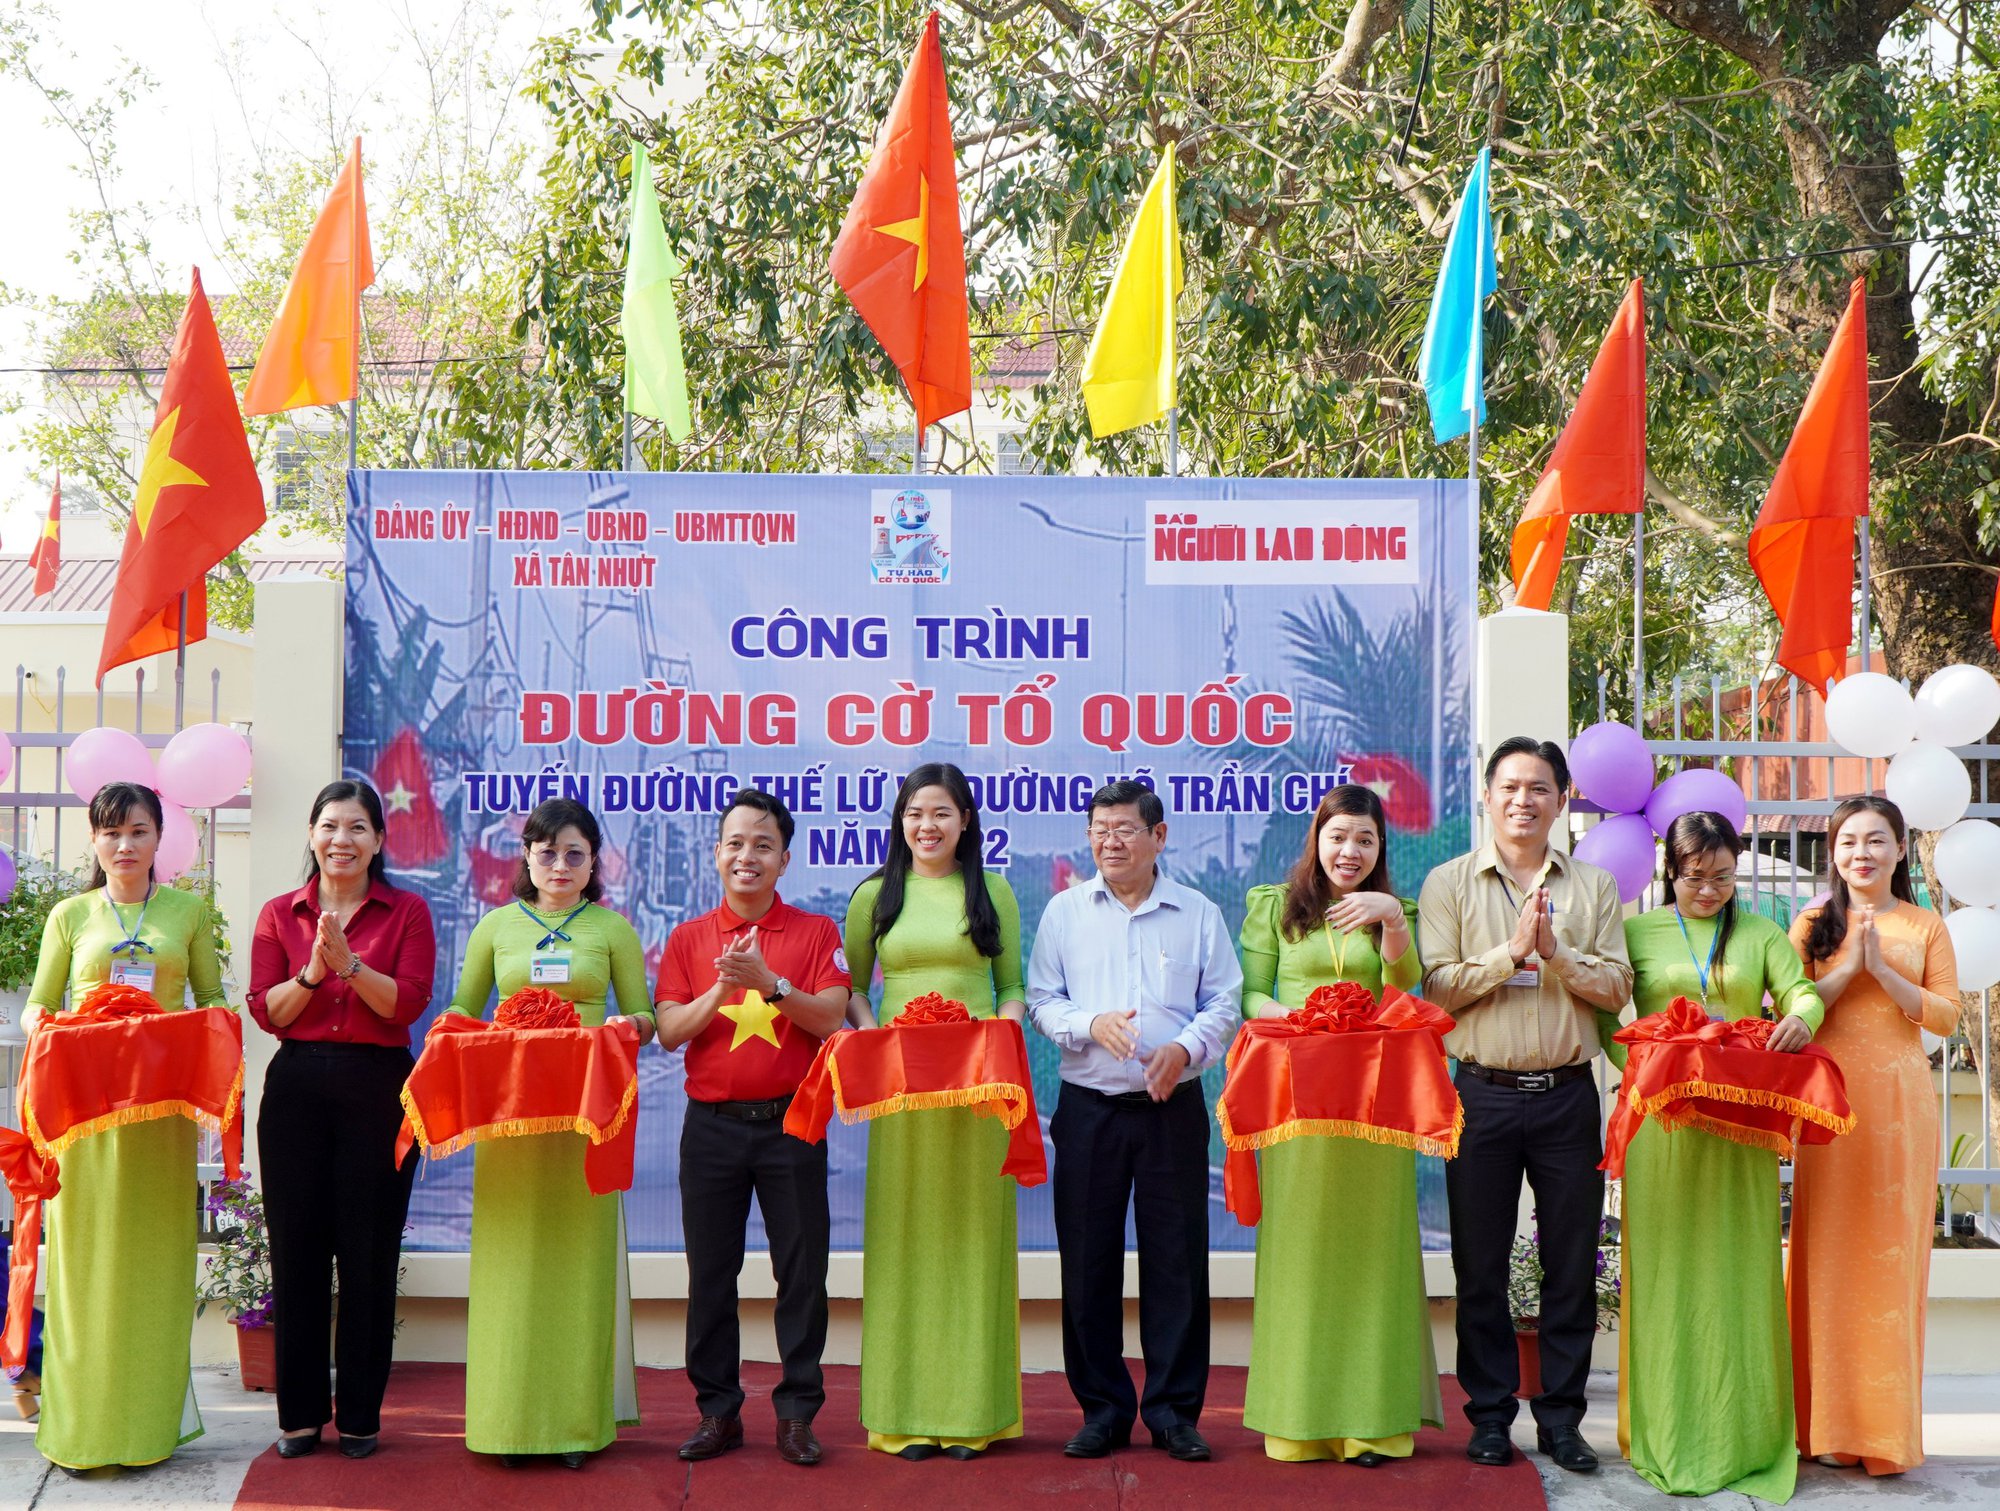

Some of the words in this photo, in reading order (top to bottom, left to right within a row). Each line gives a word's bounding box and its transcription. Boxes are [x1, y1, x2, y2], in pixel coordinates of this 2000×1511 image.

[375, 503, 434, 539] ĐẢNG
[442, 503, 471, 540] ỦY
[498, 511, 559, 541] HĐND
[587, 511, 648, 542] UBND
[675, 512, 796, 546] UBMTTQVN
[1154, 512, 1198, 525] BÁO
[1154, 524, 1246, 562] NGƯỜI
[1256, 527, 1313, 561] LAO
[1322, 524, 1406, 563] ĐỘNG
[514, 552, 543, 586] XÃ
[549, 552, 590, 587] TÂN
[598, 553, 656, 593] NHỰT
[731, 608, 888, 659] CÔNG
[916, 608, 1089, 659] TRÌNH
[519, 681, 796, 746] ĐƯỜNG
[826, 682, 934, 746] CỜ
[958, 674, 1057, 746] TỔ
[1083, 676, 1293, 752] QUỐC
[465, 763, 589, 812] TUYẾN
[603, 767, 739, 812] ĐƯỜNG
[752, 764, 826, 812] THẾ
[837, 768, 888, 812] LỮ
[1169, 763, 1270, 812] TRẦN
